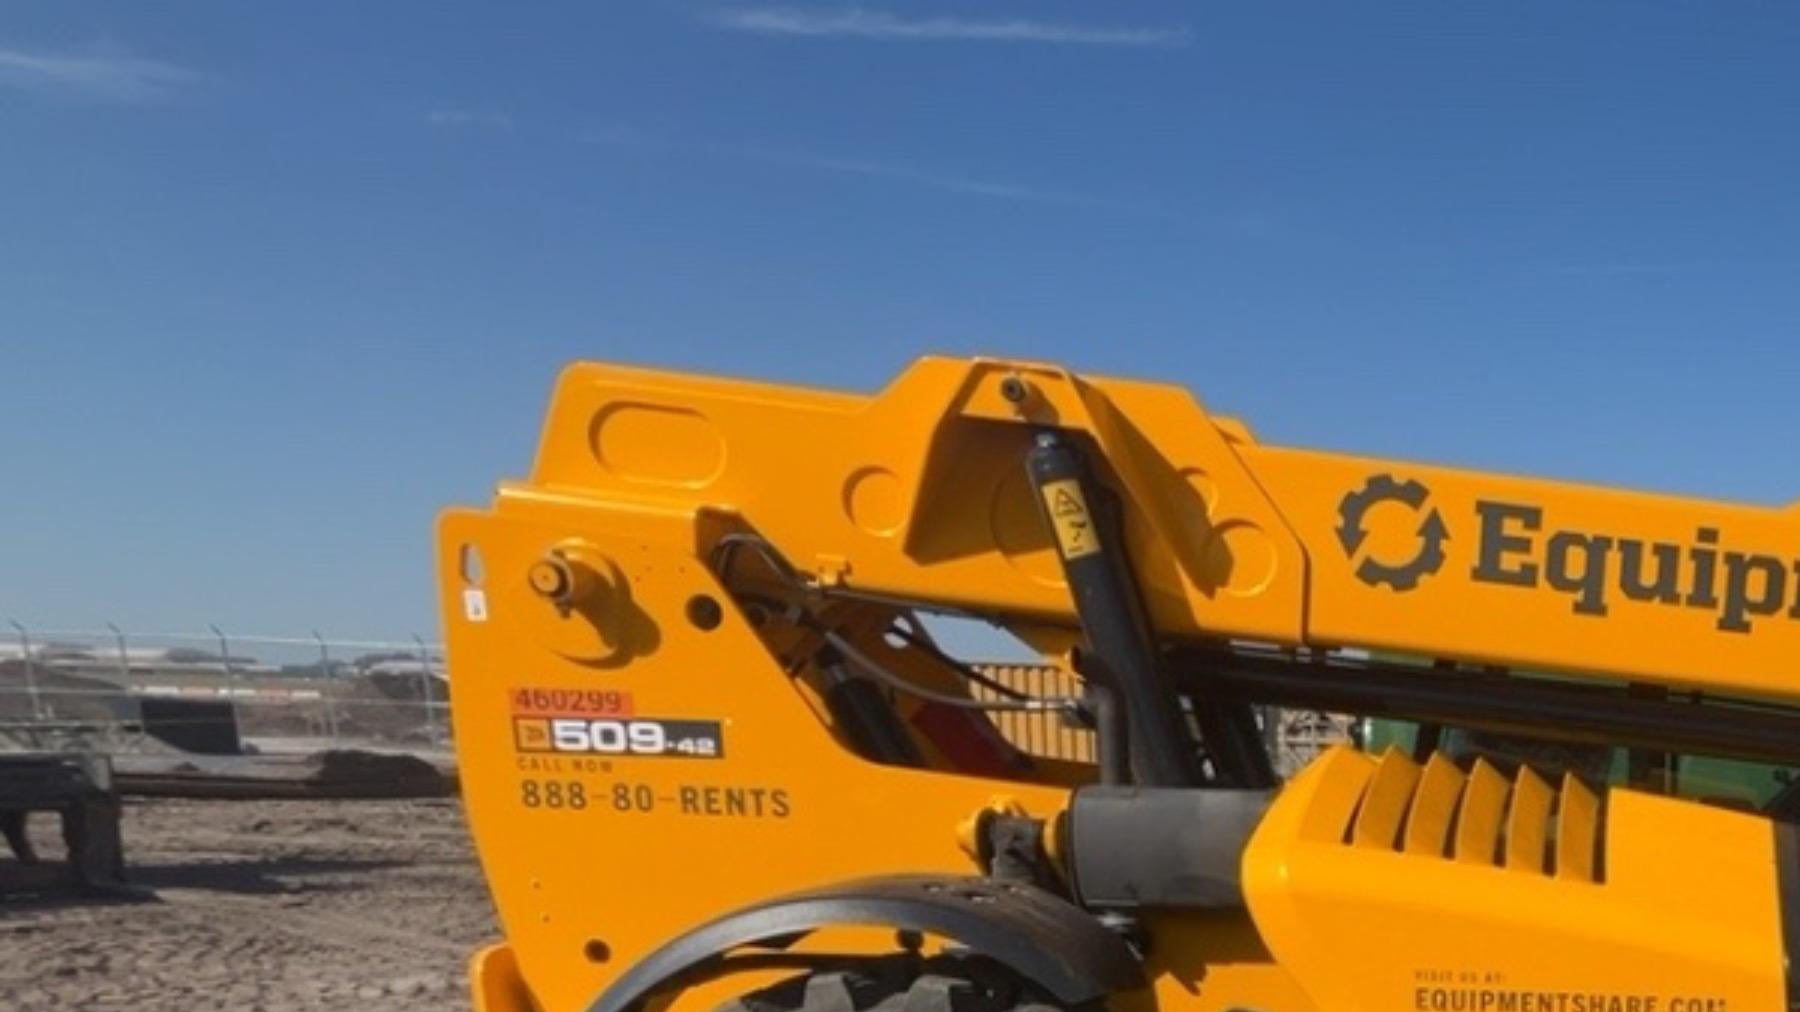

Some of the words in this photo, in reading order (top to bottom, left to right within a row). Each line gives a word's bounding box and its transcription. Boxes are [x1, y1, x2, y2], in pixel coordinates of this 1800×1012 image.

[515, 688, 623, 712] 460299
[516, 758, 562, 772] CALL
[571, 760, 614, 774] NOW
[521, 779, 791, 818] 888-80-RENTS
